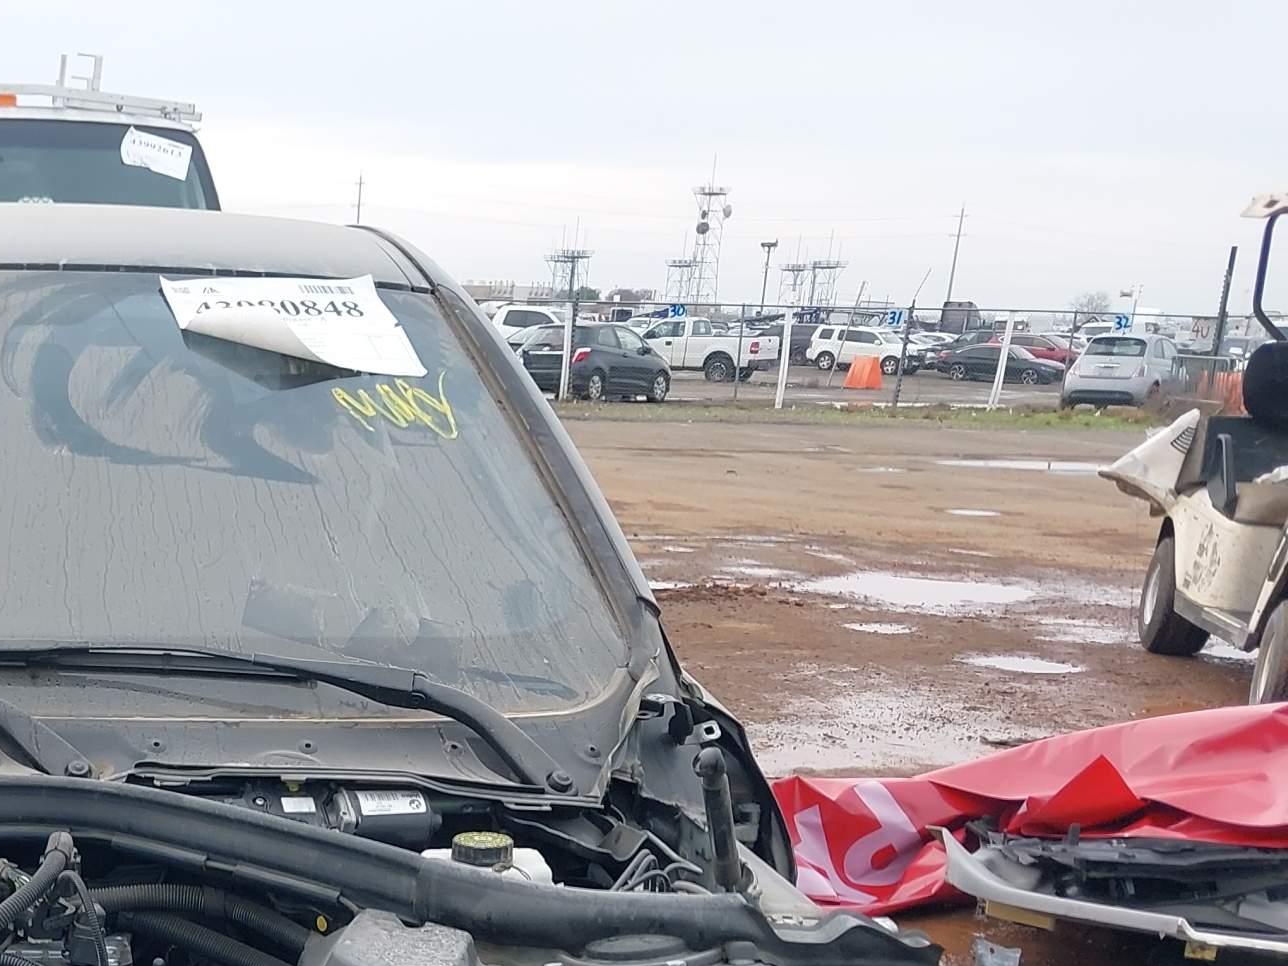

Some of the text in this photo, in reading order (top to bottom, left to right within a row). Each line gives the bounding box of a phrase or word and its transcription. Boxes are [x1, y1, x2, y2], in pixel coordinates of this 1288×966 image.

[669, 304, 686, 318] 30
[887, 310, 903, 325] 31
[1115, 315, 1131, 330] 32
